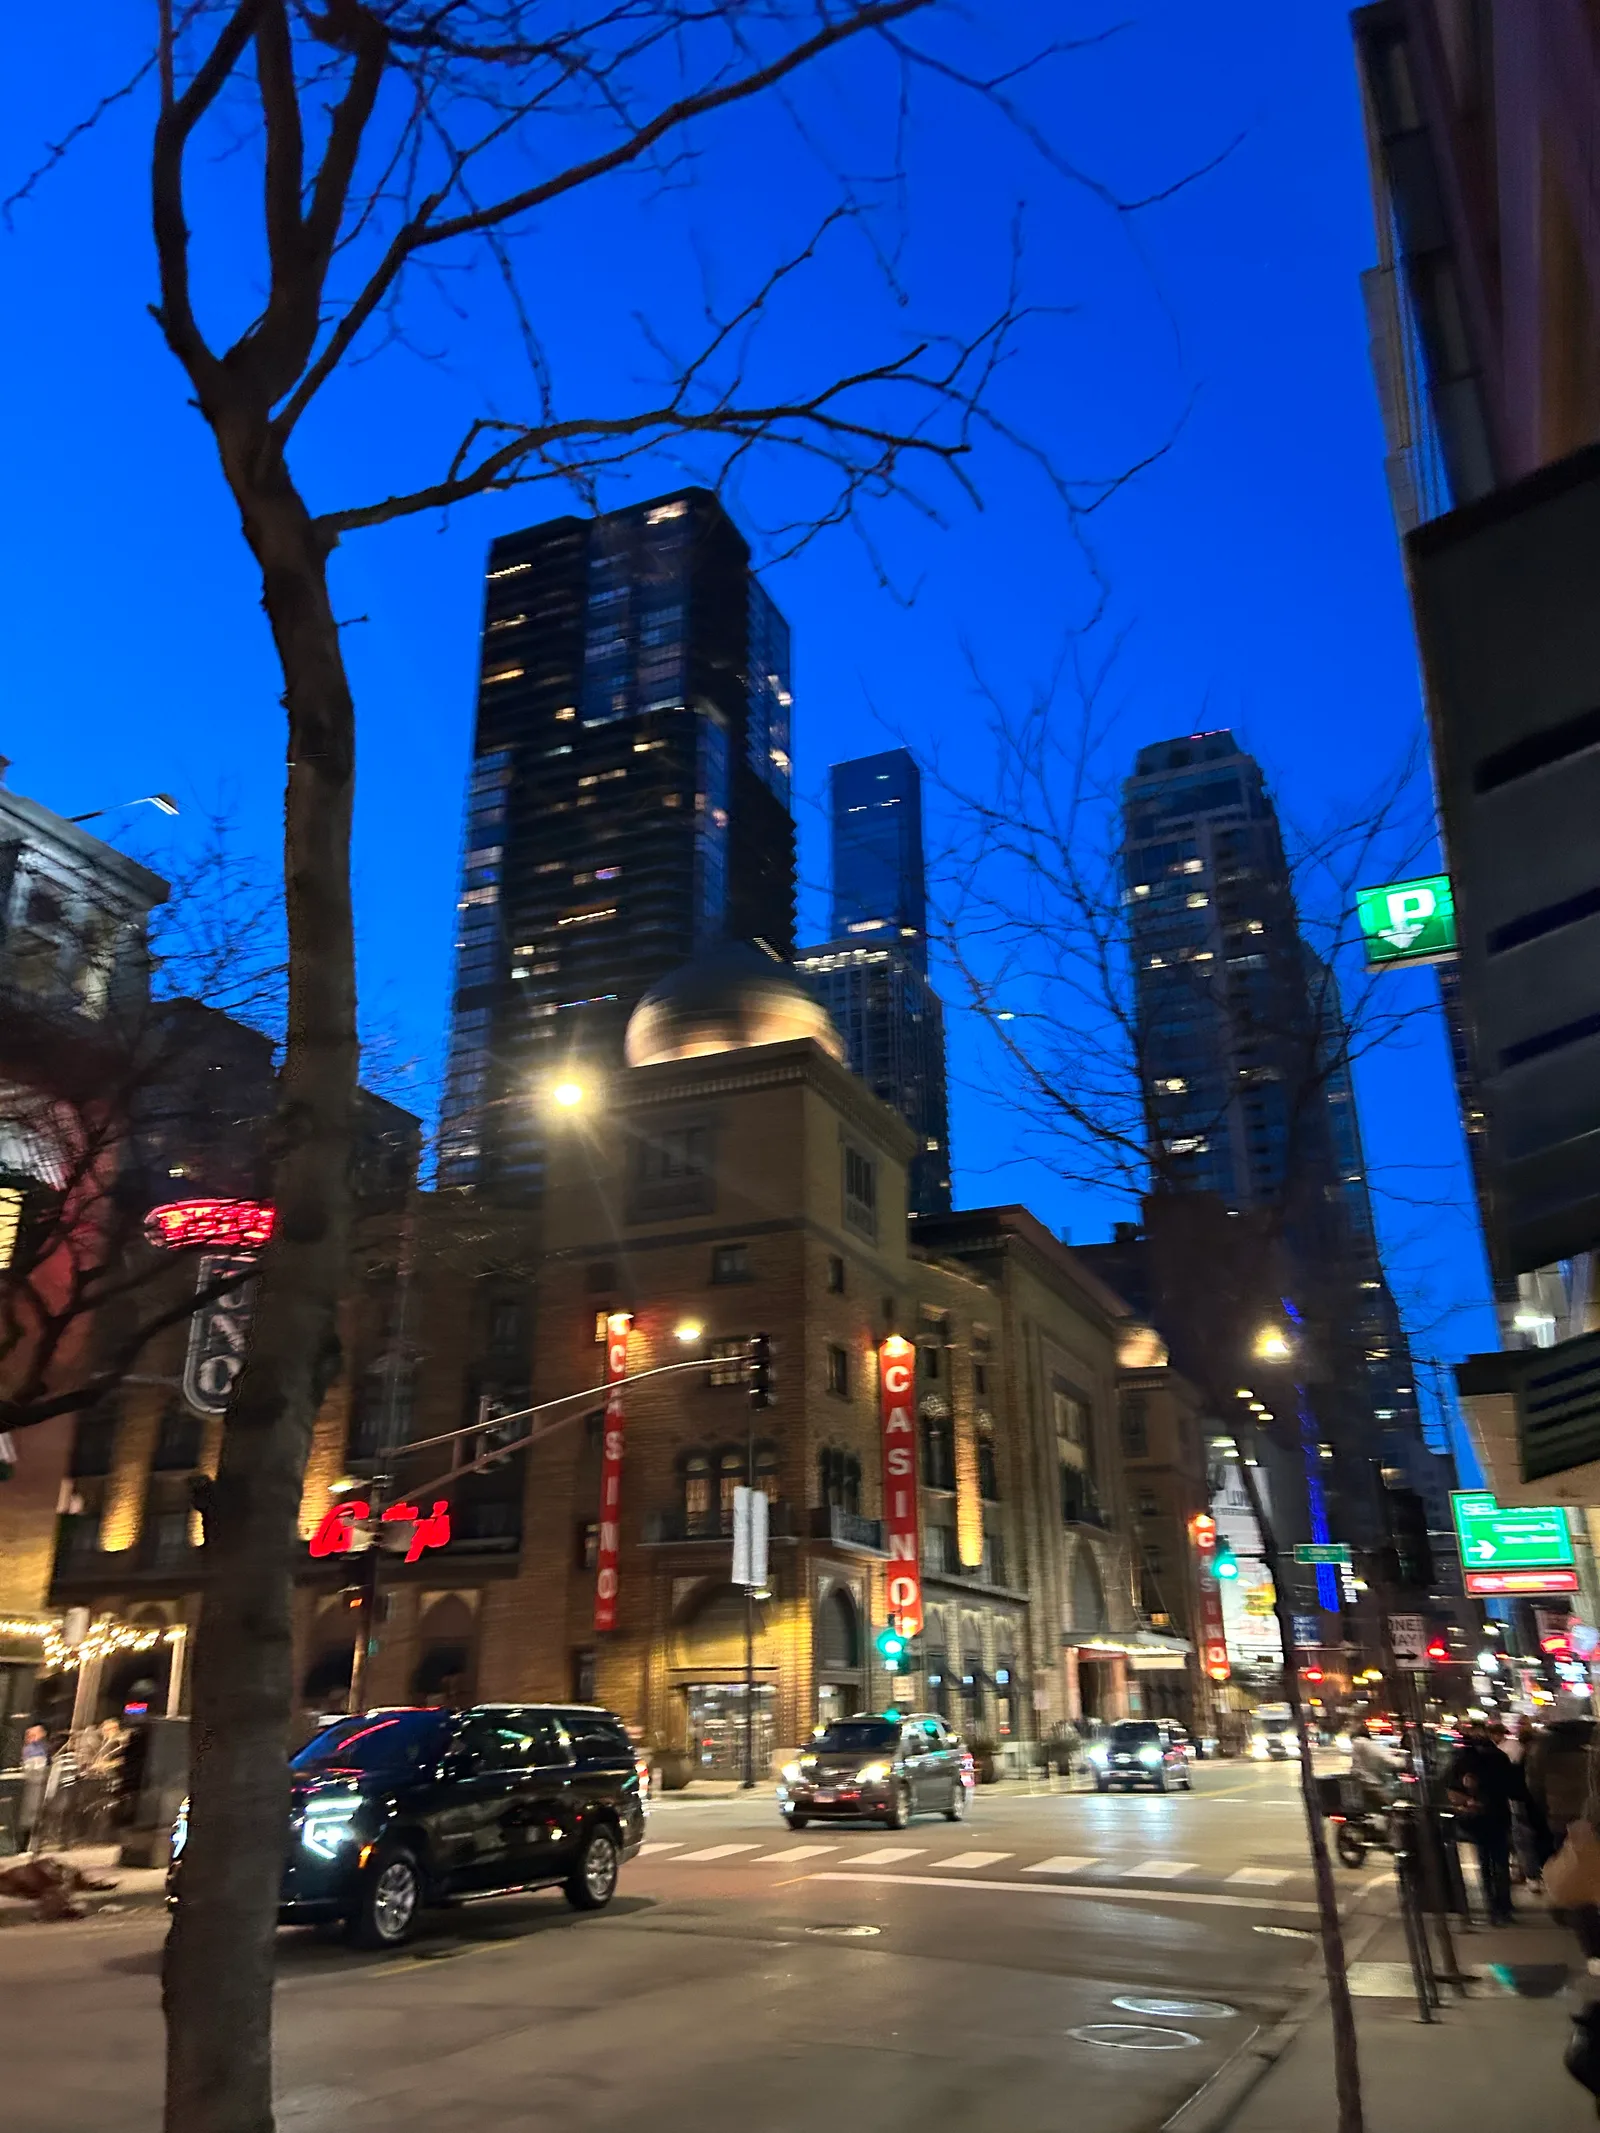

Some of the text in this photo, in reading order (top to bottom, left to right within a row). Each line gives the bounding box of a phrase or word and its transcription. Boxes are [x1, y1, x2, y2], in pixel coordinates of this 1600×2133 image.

[1387, 889, 1436, 928] P
[597, 1345, 625, 1601] CASINO
[886, 1366, 917, 1607] CASINO
